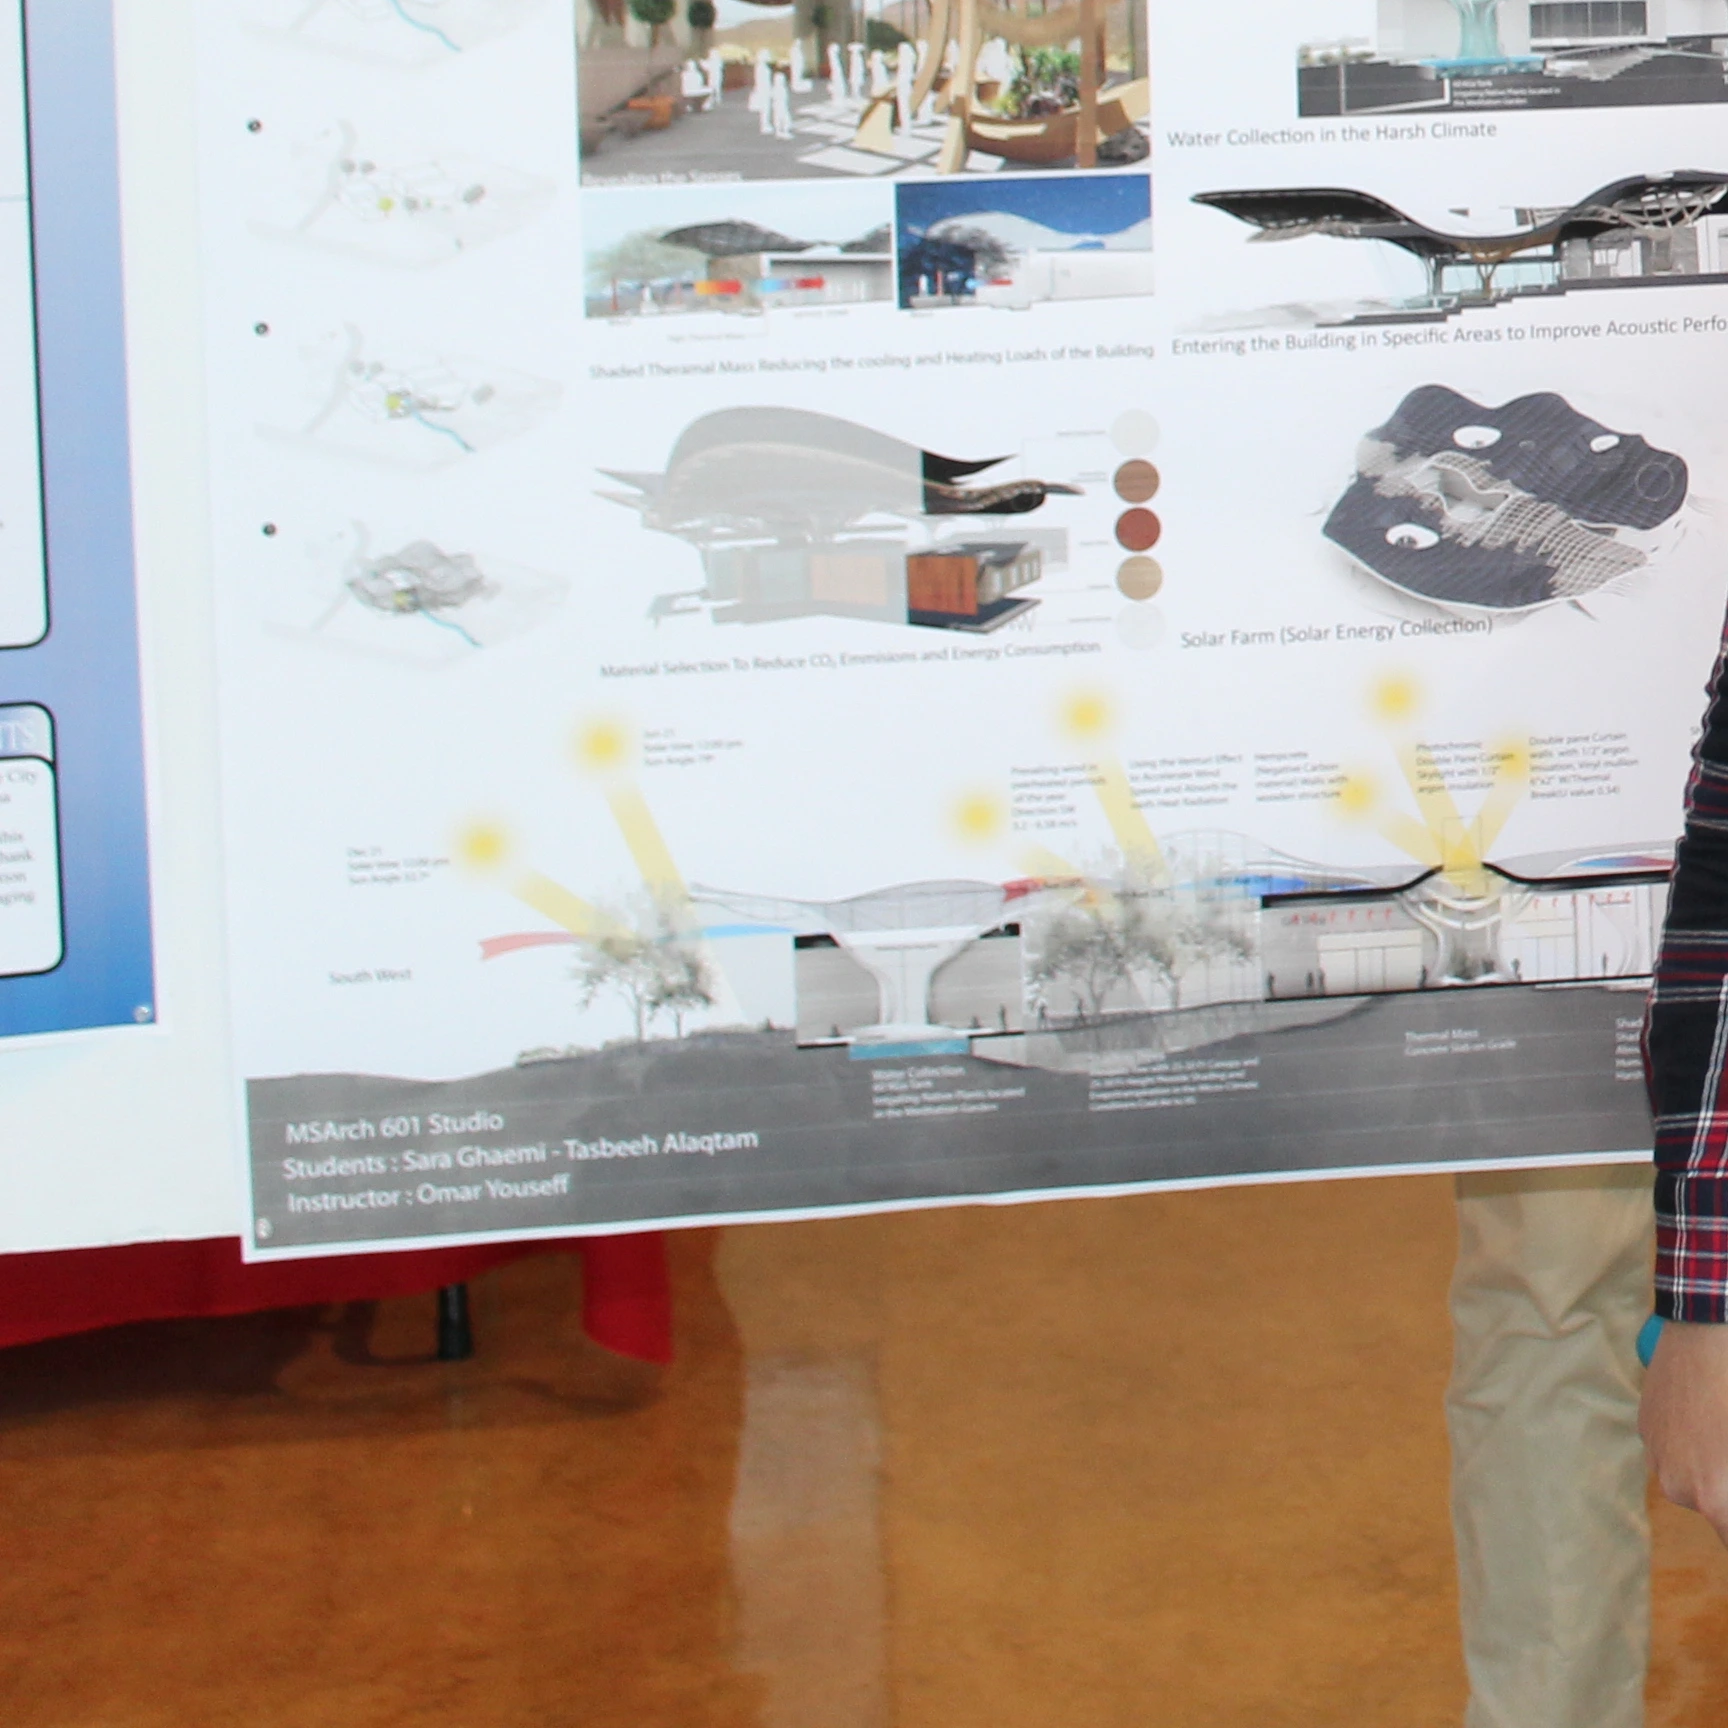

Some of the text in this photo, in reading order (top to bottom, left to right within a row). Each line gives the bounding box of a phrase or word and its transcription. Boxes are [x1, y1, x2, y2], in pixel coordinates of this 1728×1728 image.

[1167, 121, 1497, 147] Water Collection in the Harsh Climate
[1171, 337, 1246, 358] Entering
[1250, 336, 1280, 351] the
[1285, 333, 1357, 353] Building
[1361, 335, 1378, 345] in
[1382, 328, 1448, 348] Specific
[1453, 326, 1502, 342] Areas
[1507, 327, 1525, 340] to
[1530, 323, 1601, 341] Improve
[1606, 319, 1678, 335] Acoustic
[588, 365, 644, 379] Shaded
[718, 360, 754, 374] Mass
[758, 357, 827, 375] Reducing
[830, 357, 853, 368] the
[857, 354, 911, 371] cooling
[915, 352, 943, 366] and
[945, 350, 1003, 367] Heating
[1050, 346, 1065, 360] of
[1069, 346, 1092, 359] the
[1095, 343, 1154, 361] Building
[1181, 616, 1493, 649] Solar Farm (Solar Energy Collection)
[286, 1110, 504, 1144] MSArch 601 Studio
[282, 1128, 760, 1180] Students Sara Ghaemi Tasbeeh Alaqtam
[287, 1173, 571, 1212] Instructor Omar Youseff
